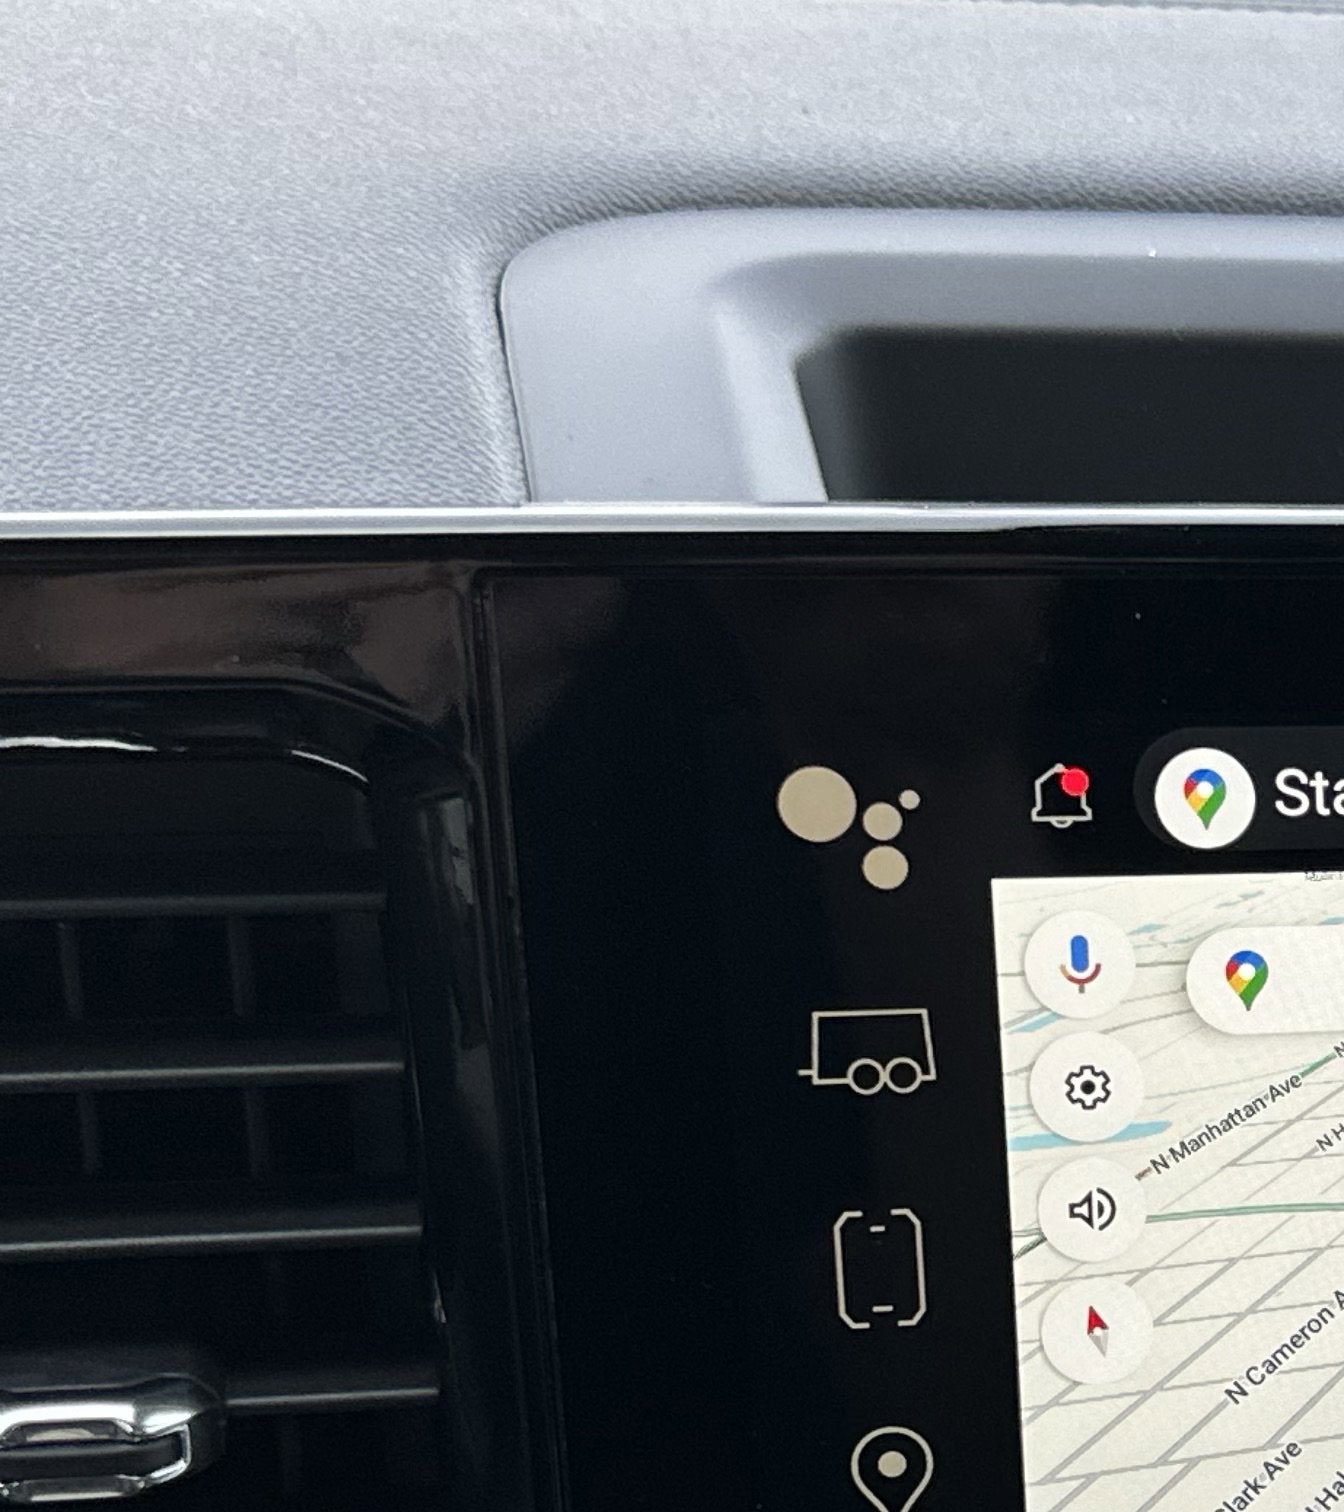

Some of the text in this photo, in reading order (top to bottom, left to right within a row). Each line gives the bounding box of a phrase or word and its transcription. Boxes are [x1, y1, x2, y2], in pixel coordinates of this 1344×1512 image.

[1150, 1073, 1302, 1175] N Manhattan Ave
[1316, 1134, 1333, 1152] N
[1225, 1381, 1249, 1404] N
[1245, 1307, 1335, 1386] Cameron
[1263, 1442, 1302, 1481] Ave
